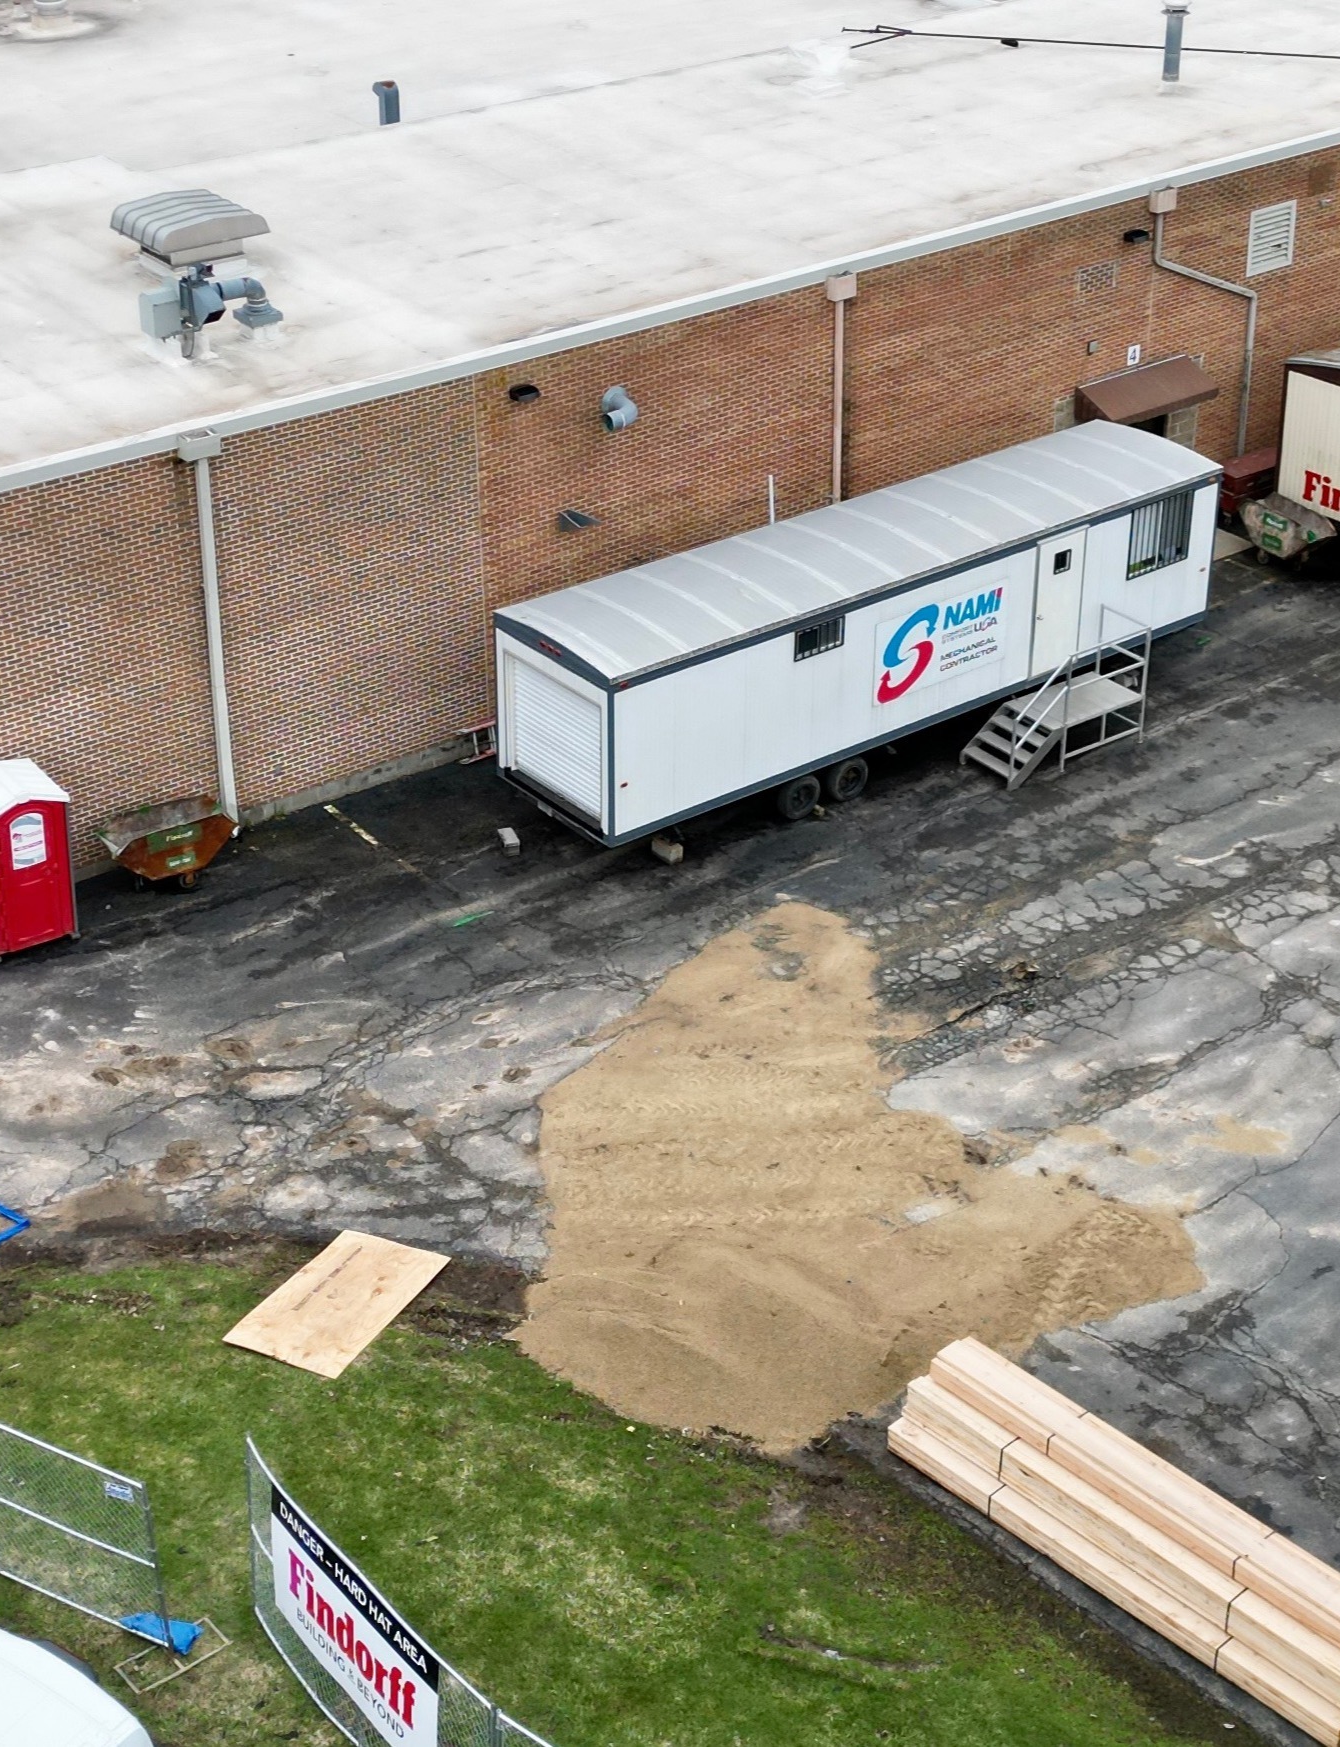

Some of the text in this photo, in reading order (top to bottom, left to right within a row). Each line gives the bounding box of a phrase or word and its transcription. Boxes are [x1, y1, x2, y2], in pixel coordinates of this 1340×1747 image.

[1128, 347, 1137, 362] 4
[943, 587, 1003, 630] NAMI
[940, 636, 996, 661] MECHANICAL
[940, 645, 998, 672] CONTRACTOR
[279, 1502, 325, 1562] DANGER
[334, 1562, 367, 1606] HARD
[368, 1603, 393, 1636] HAT
[393, 1630, 428, 1674] AREA
[287, 1547, 417, 1730] Findorff
[296, 1606, 346, 1674] BUILDING
[356, 1677, 405, 1739] BEYOND
